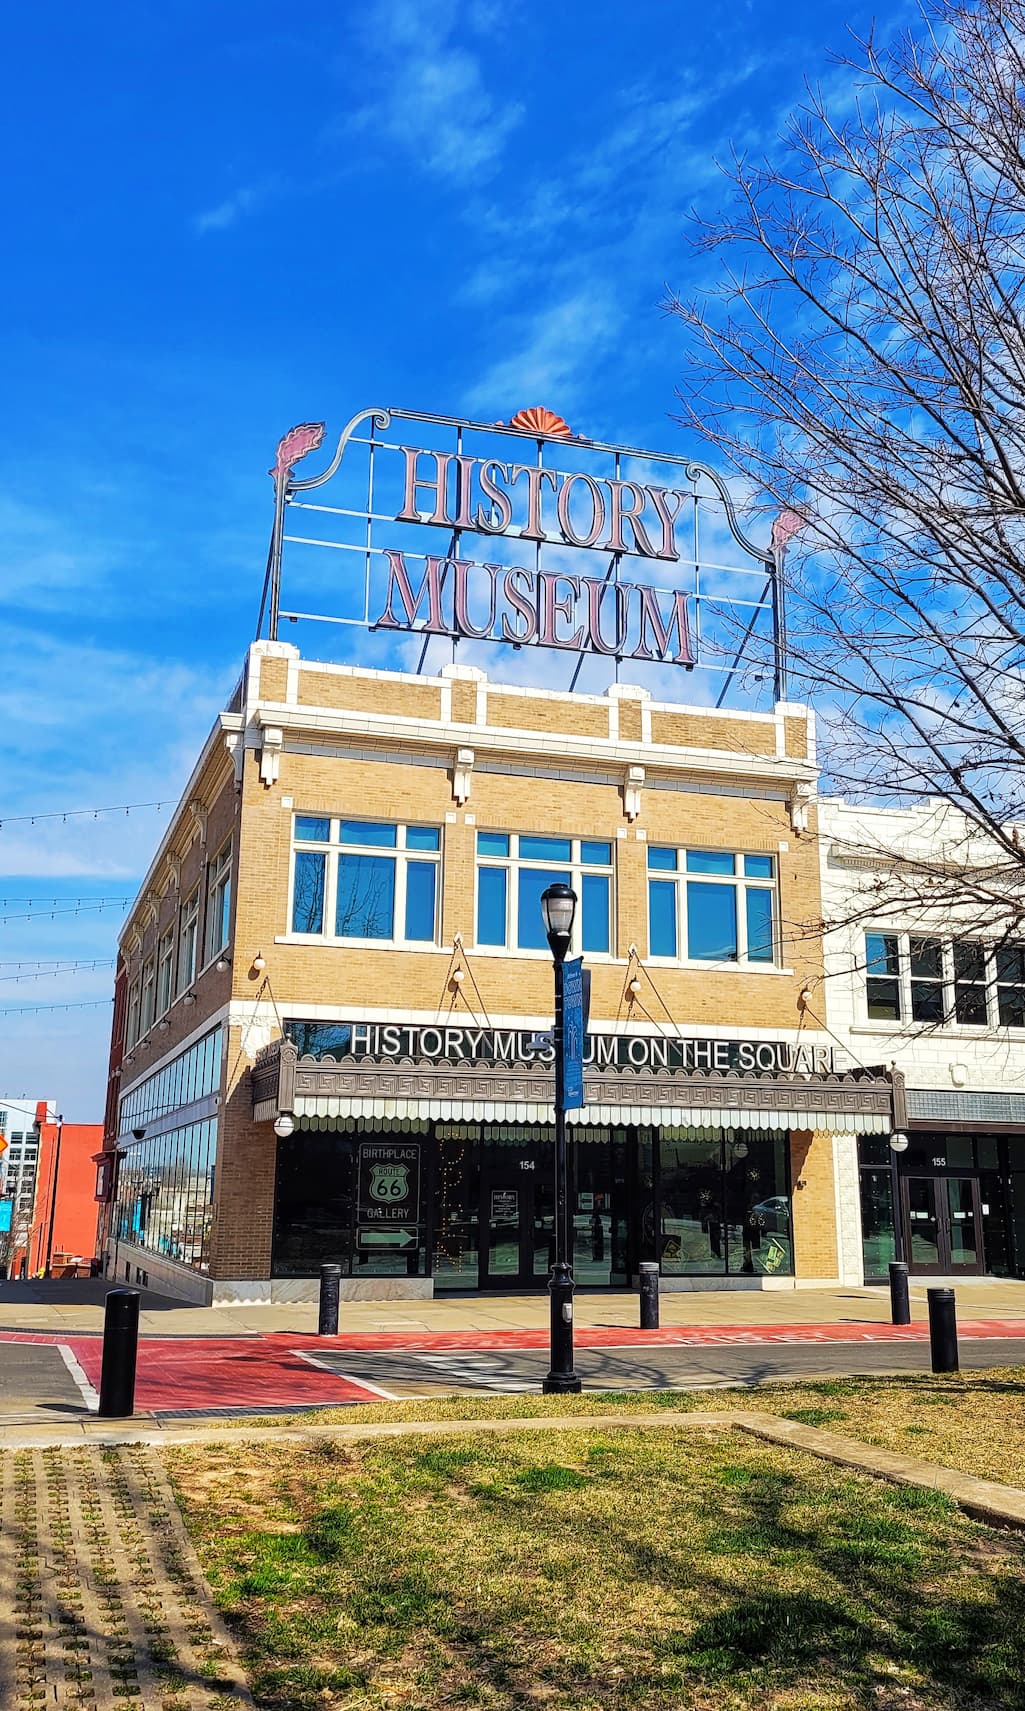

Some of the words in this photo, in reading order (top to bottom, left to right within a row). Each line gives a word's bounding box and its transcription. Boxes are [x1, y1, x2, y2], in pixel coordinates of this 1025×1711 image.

[398, 446, 692, 561] HISTORY
[377, 549, 695, 665] MUSEUM
[351, 1024, 483, 1059] HISTORY
[494, 1030, 618, 1065] MUSUM
[628, 1038, 667, 1066] ON
[677, 1040, 730, 1069] THE
[739, 1042, 848, 1074] SQUARE
[362, 1148, 417, 1160] BIRTHPLACE
[519, 1160, 535, 1170] 154
[932, 1157, 946, 1167] 155
[377, 1168, 401, 1176] ROUTE
[377, 1179, 401, 1196] 66
[366, 1207, 409, 1219] GALLERY
[671, 1332, 823, 1344] FIRE
